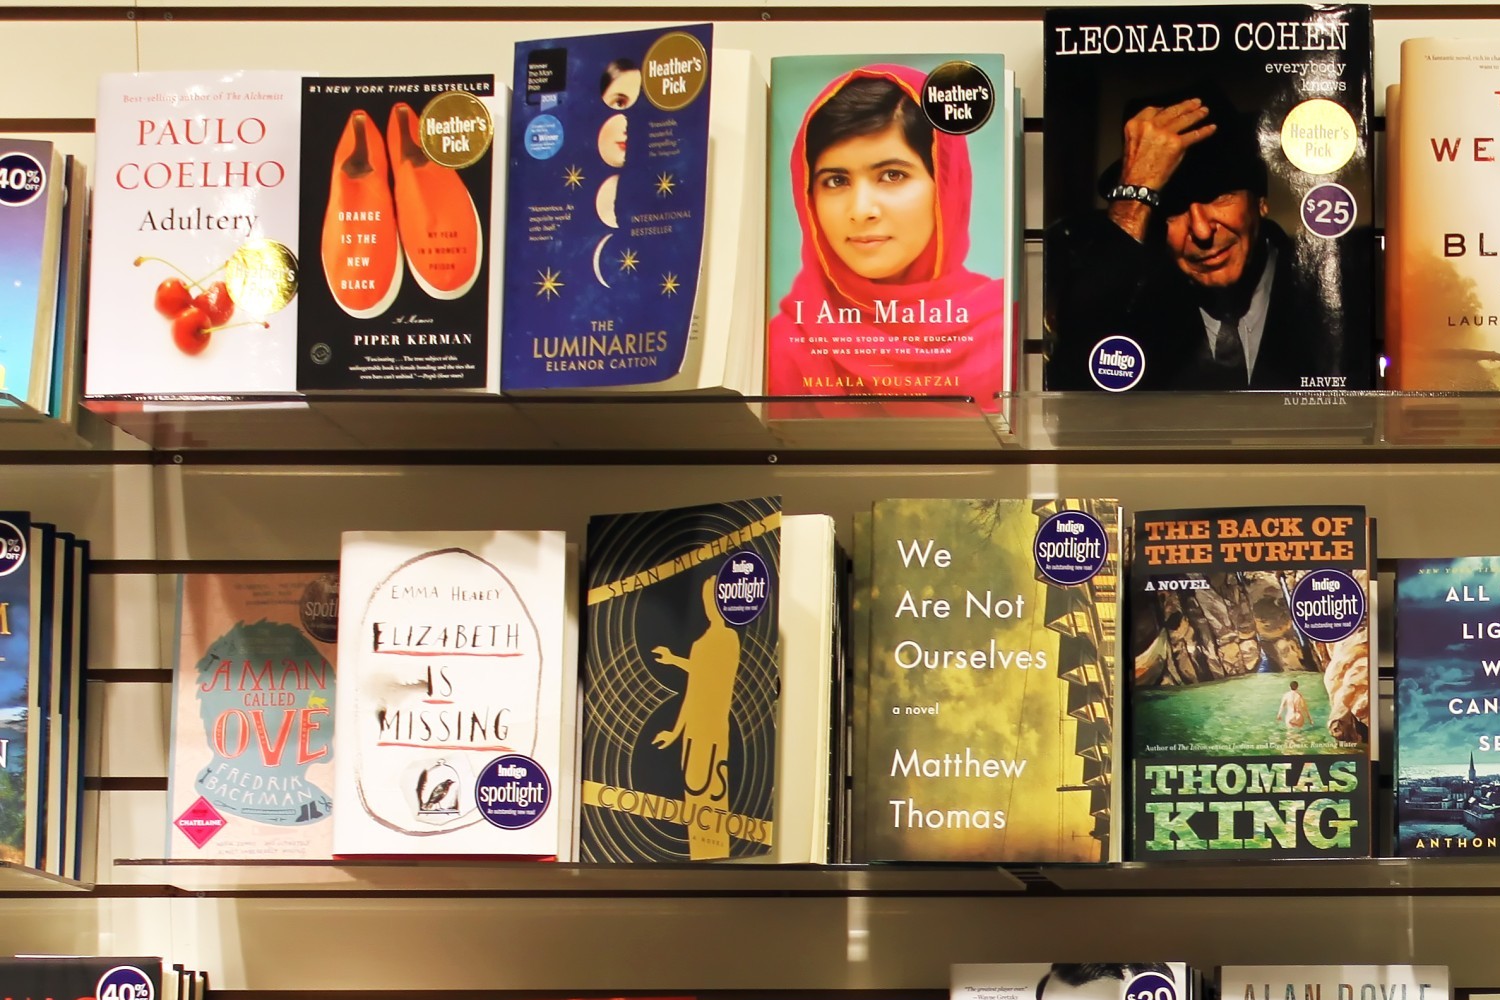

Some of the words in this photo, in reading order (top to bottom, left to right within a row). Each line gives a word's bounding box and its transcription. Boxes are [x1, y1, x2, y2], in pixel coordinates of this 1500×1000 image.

[1056, 24, 1221, 55] LEONARD
[1235, 23, 1348, 52] COHEN
[649, 57, 702, 77] Heather's
[1265, 61, 1346, 77] everybody
[309, 85, 321, 93] #1
[326, 85, 347, 93] NEW
[351, 85, 384, 93] YORK
[389, 84, 420, 92] TIMES
[424, 82, 490, 92] BESTSELLER
[663, 79, 686, 94] Pick
[1302, 78, 1346, 91] knows
[137, 117, 266, 146] PAULO
[116, 161, 285, 190] COELHO
[139, 207, 259, 236] Adultery
[1306, 199, 1349, 224] $25
[794, 301, 804, 323] I
[816, 301, 861, 323] Am
[874, 300, 969, 324] Malala
[354, 335, 400, 346] PIPER
[407, 334, 472, 345] KERMAN
[533, 331, 667, 358] LUMINARIES
[546, 359, 604, 371] ELEANOR
[611, 356, 657, 369] CATTON
[1301, 377, 1346, 387] HARVEY
[1145, 545, 1213, 566] THE
[1220, 542, 1354, 562] TURTLE
[1144, 580, 1157, 592] A
[1158, 579, 1210, 590] NOVEL
[373, 623, 521, 652] ELIZABETH
[895, 639, 1047, 670] Ourselves
[378, 709, 511, 742] MISSING
[891, 749, 1027, 778] Matthew
[480, 781, 544, 806] spotlight
[598, 785, 767, 844] CONDUCTORS
[1145, 799, 1358, 851] KING
